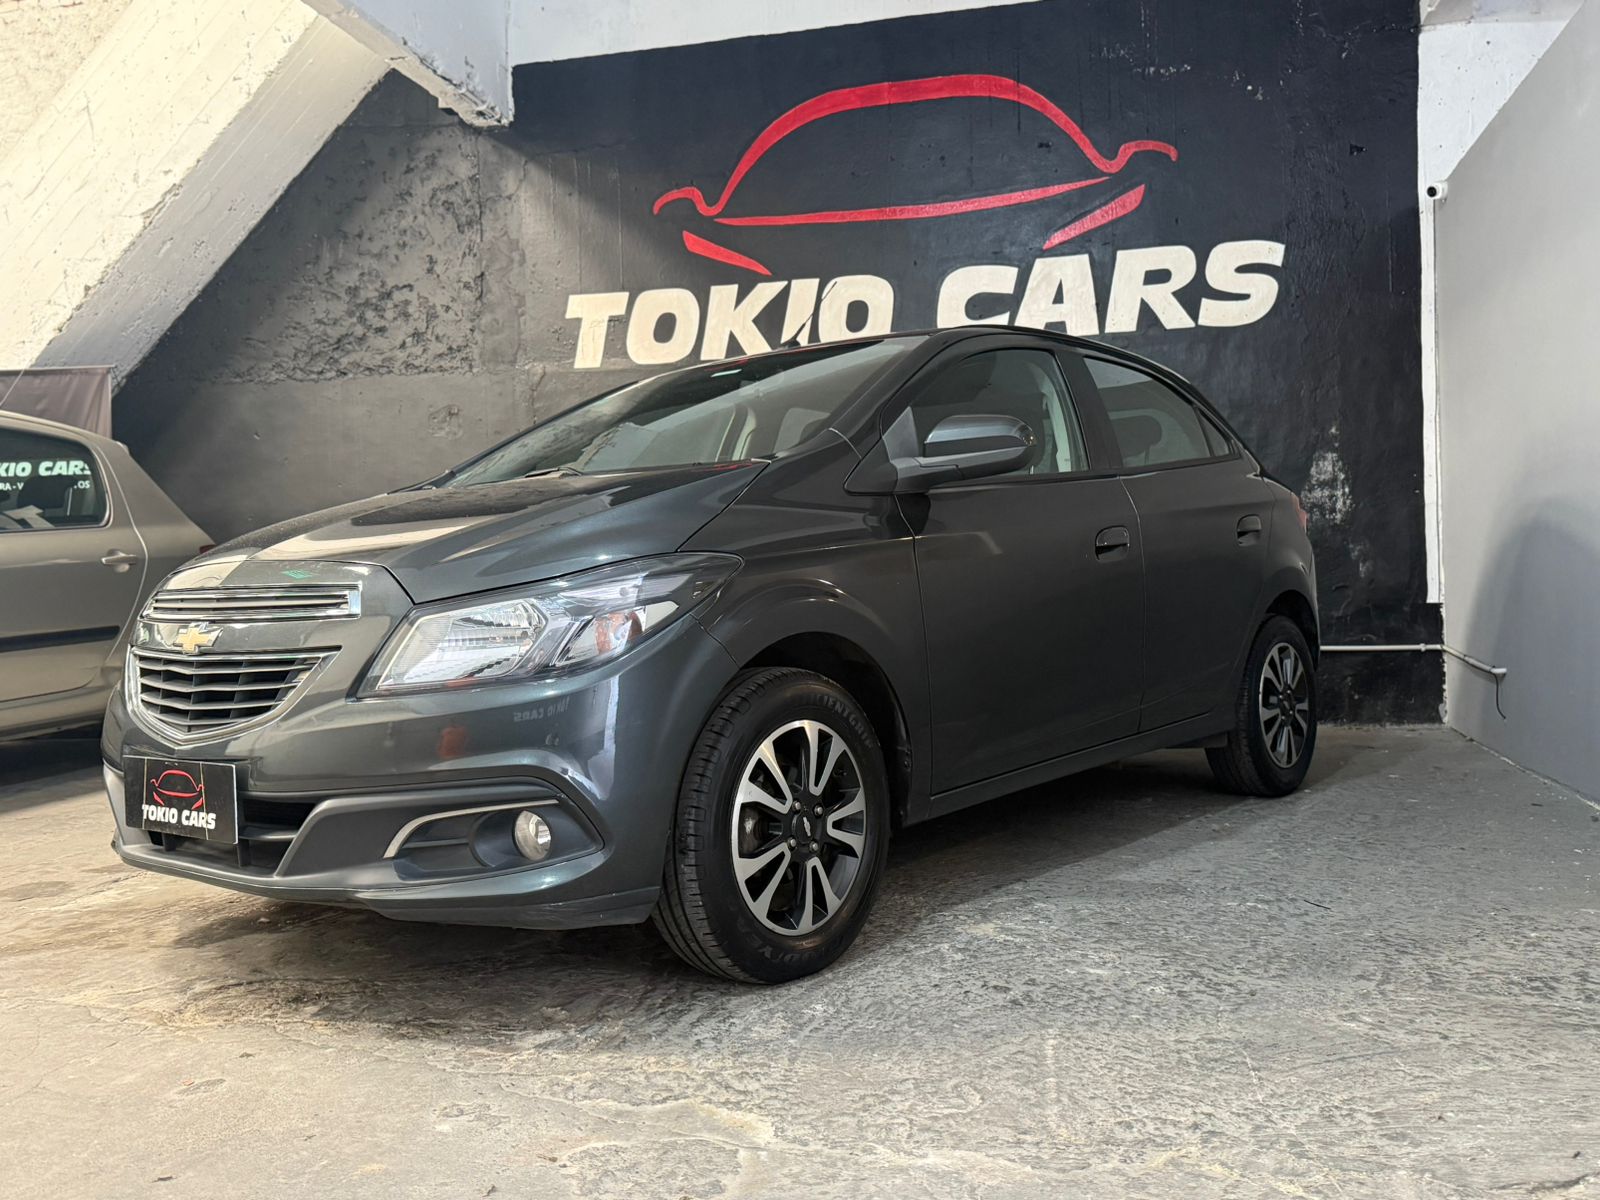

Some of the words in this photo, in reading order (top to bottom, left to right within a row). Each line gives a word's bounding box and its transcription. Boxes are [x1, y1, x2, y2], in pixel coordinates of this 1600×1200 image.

[565, 274, 895, 369] TOKIO
[937, 239, 1286, 337] CARS
[142, 804, 178, 824] TOKIO
[181, 809, 217, 830] CARS
